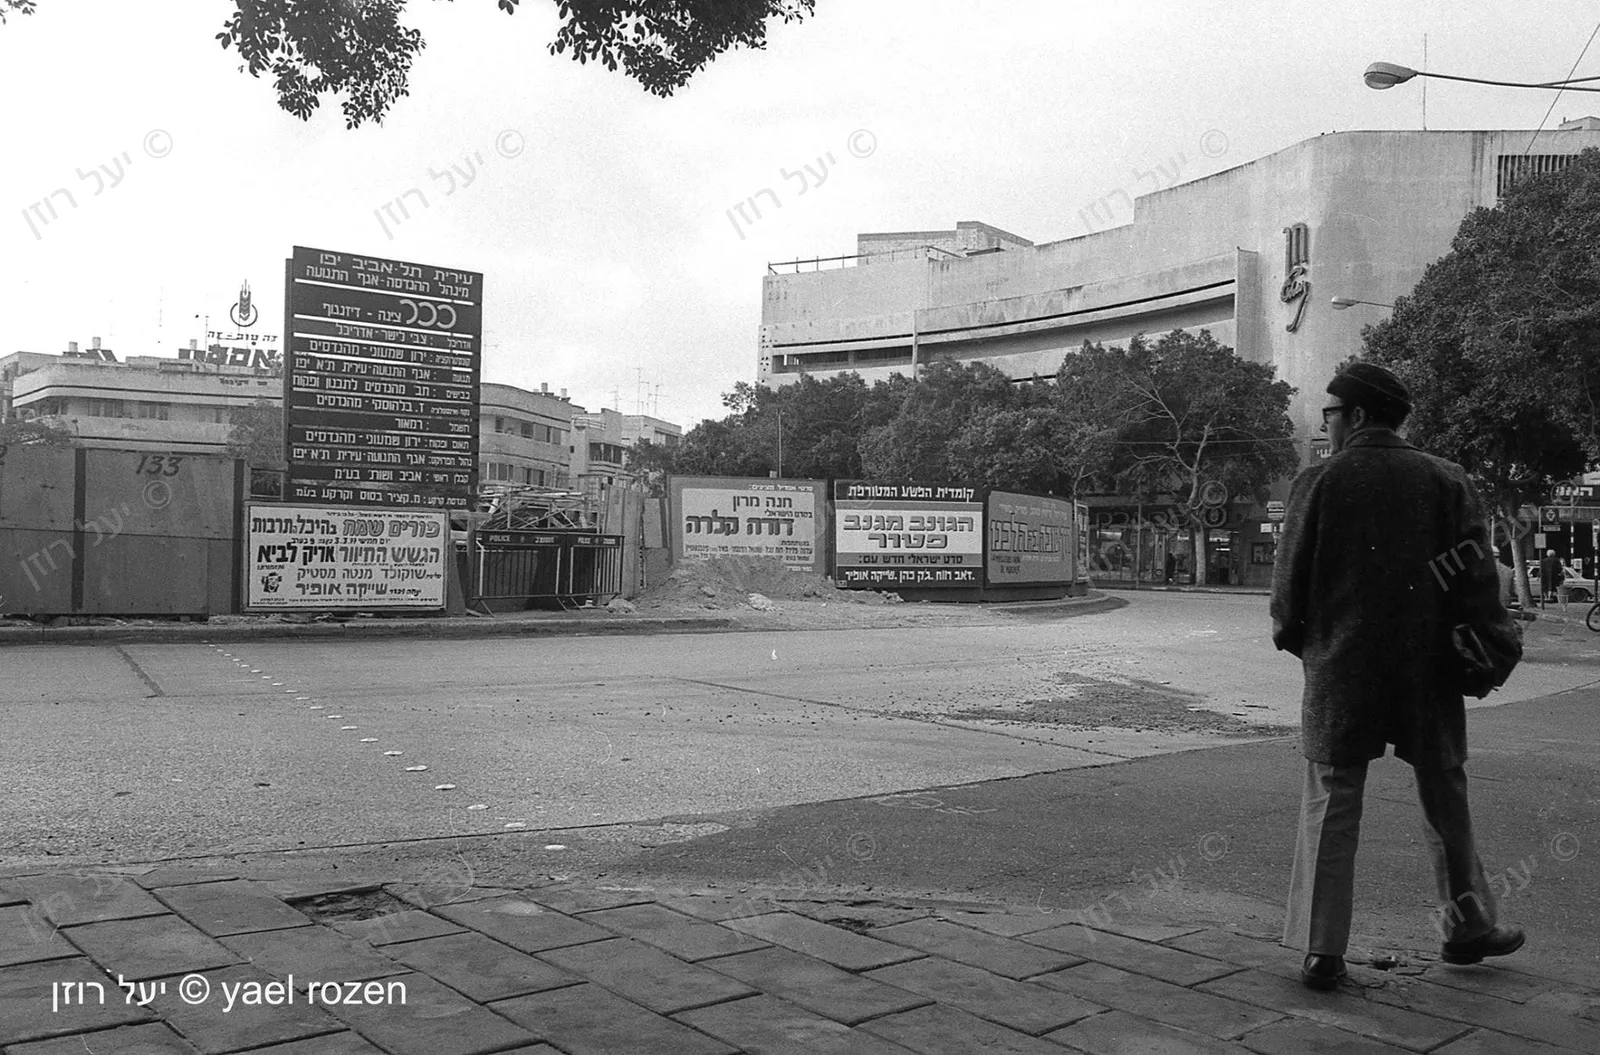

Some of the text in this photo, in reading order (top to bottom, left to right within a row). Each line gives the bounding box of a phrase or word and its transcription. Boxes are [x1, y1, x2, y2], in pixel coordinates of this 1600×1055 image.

[320, 253, 341, 266] יפו
[306, 265, 349, 281] התנועה
[433, 270, 473, 285] עירית
[438, 282, 469, 298] מינהל
[323, 303, 361, 318] דיזנגוף
[378, 310, 402, 322] צינה
[410, 333, 427, 345] צבי
[309, 340, 360, 355] מהנדסים
[369, 346, 404, 359] שמעוני
[295, 358, 310, 368] יפו
[410, 351, 427, 362] ירון
[411, 368, 431, 380] אגף
[325, 378, 358, 391] לתכנון
[364, 381, 406, 395] מהנדסים
[316, 394, 362, 408] מהנדסים
[305, 430, 356, 444] מהנדסים
[366, 434, 400, 446] שמעוני
[404, 436, 421, 447] ירון
[406, 453, 426, 465] אגף
[136, 456, 182, 477] 133
[399, 471, 422, 482] אביב
[321, 488, 353, 501] וקרקע
[848, 485, 975, 503] קומדית הפשע המטורפת
[733, 496, 792, 512] חנה מרון
[343, 519, 385, 537] שמח
[388, 520, 440, 538] פורים
[686, 509, 795, 536] דודה קלרה
[843, 514, 974, 532] הגונב מגנב
[490, 535, 511, 543] POLICE
[867, 533, 948, 549] פטור
[257, 542, 440, 566] הגשש החיוור אריק לביא
[882, 555, 905, 564] חדש
[908, 553, 941, 564] ישראלי
[944, 555, 963, 564] סרט
[297, 568, 336, 581] מסטיק
[342, 568, 373, 580] מנטה
[380, 564, 427, 582] שוקולד
[845, 570, 869, 581] אופיר
[899, 570, 915, 583] כהן
[295, 583, 342, 596] אופיר
[346, 583, 388, 598] שייקה
